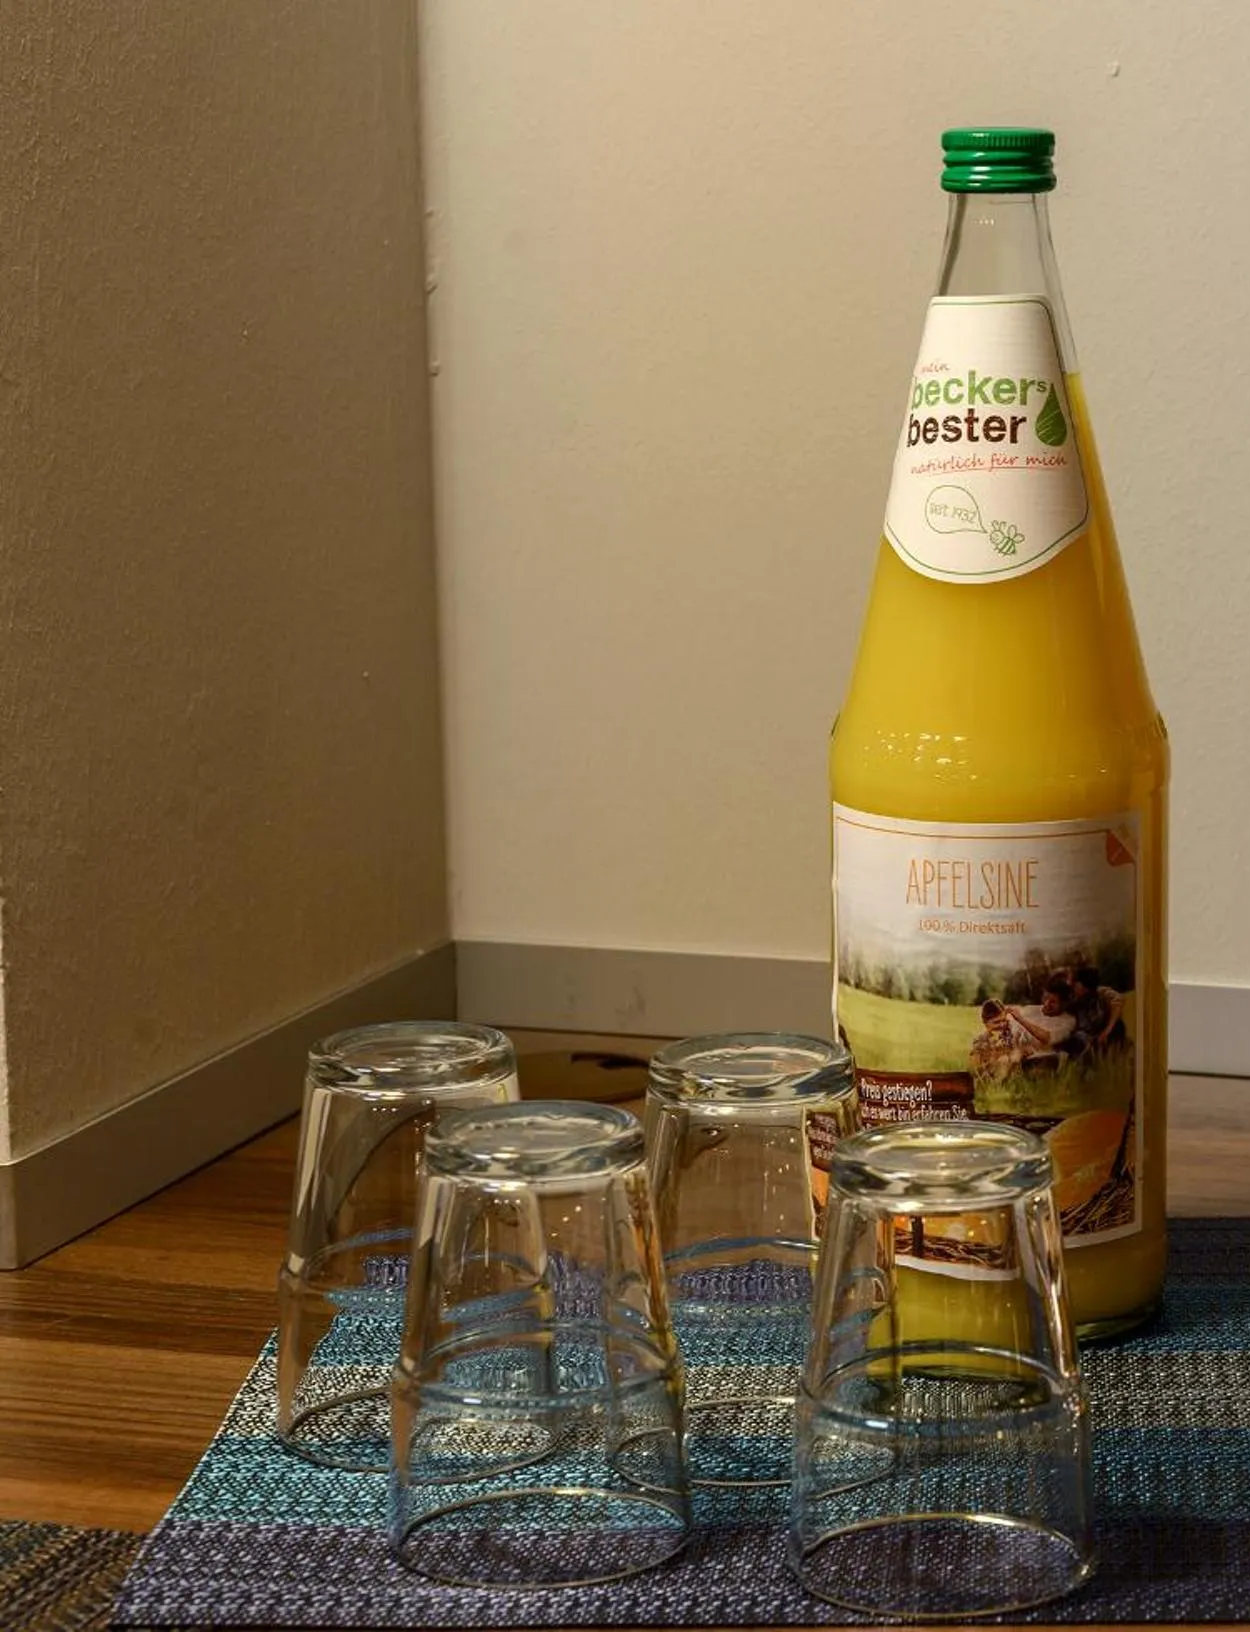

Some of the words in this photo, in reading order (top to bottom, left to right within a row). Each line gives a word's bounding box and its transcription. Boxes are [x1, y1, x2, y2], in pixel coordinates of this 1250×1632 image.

[907, 408, 1027, 447] bester
[911, 453, 984, 475] natürlich
[988, 452, 1019, 472] für
[1026, 451, 1068, 466] mich
[906, 859, 1039, 909] APFELSINE
[919, 919, 940, 932] 100
[882, 1080, 933, 1108] gestiegen?
[898, 1104, 911, 1121] bin
[912, 1103, 951, 1121] erfahren
